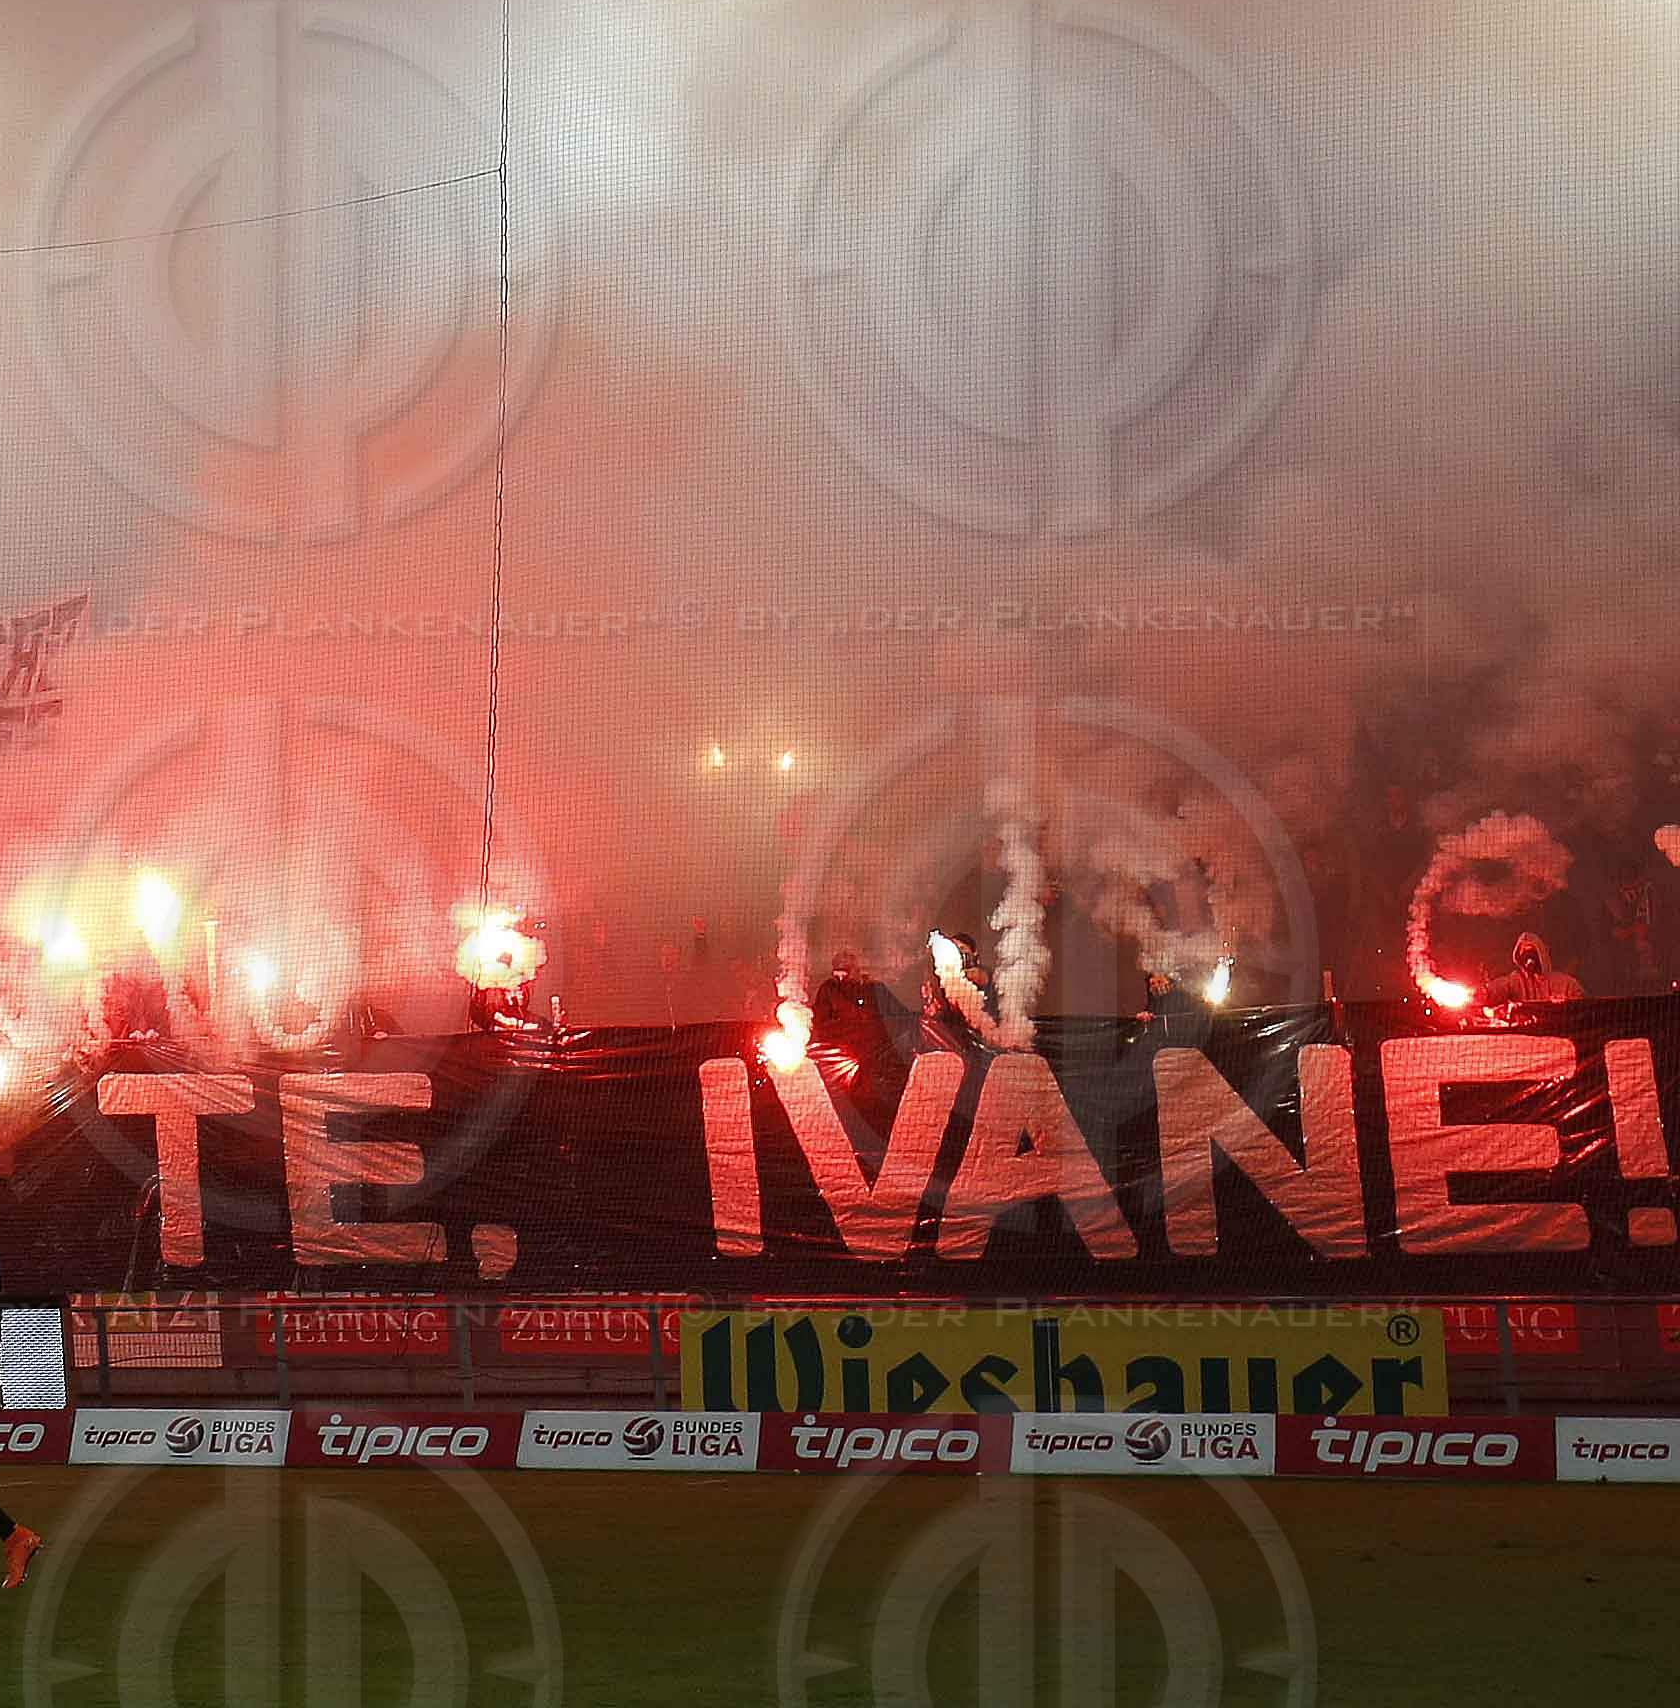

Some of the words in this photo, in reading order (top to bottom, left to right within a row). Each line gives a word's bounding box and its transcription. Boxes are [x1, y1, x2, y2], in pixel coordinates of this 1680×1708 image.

[97, 1072, 518, 1281] TE.
[700, 1035, 1677, 1259] IVANE!
[267, 1310, 439, 1344] ZEITUNG
[83, 1425, 156, 1448] tipico
[212, 1420, 276, 1434] BUNDES
[208, 1433, 274, 1455] LIGA
[318, 1414, 489, 1464] tipico
[532, 1423, 613, 1450] tipico
[673, 1420, 743, 1435] BUNDES
[672, 1435, 743, 1457] LIGA
[790, 1414, 980, 1467] tipico
[1025, 1428, 1113, 1456] tipico
[1180, 1423, 1257, 1438] BUNDES
[1180, 1438, 1259, 1461] LIGA
[1311, 1416, 1520, 1473] tipico
[1572, 1436, 1670, 1463] tipico
